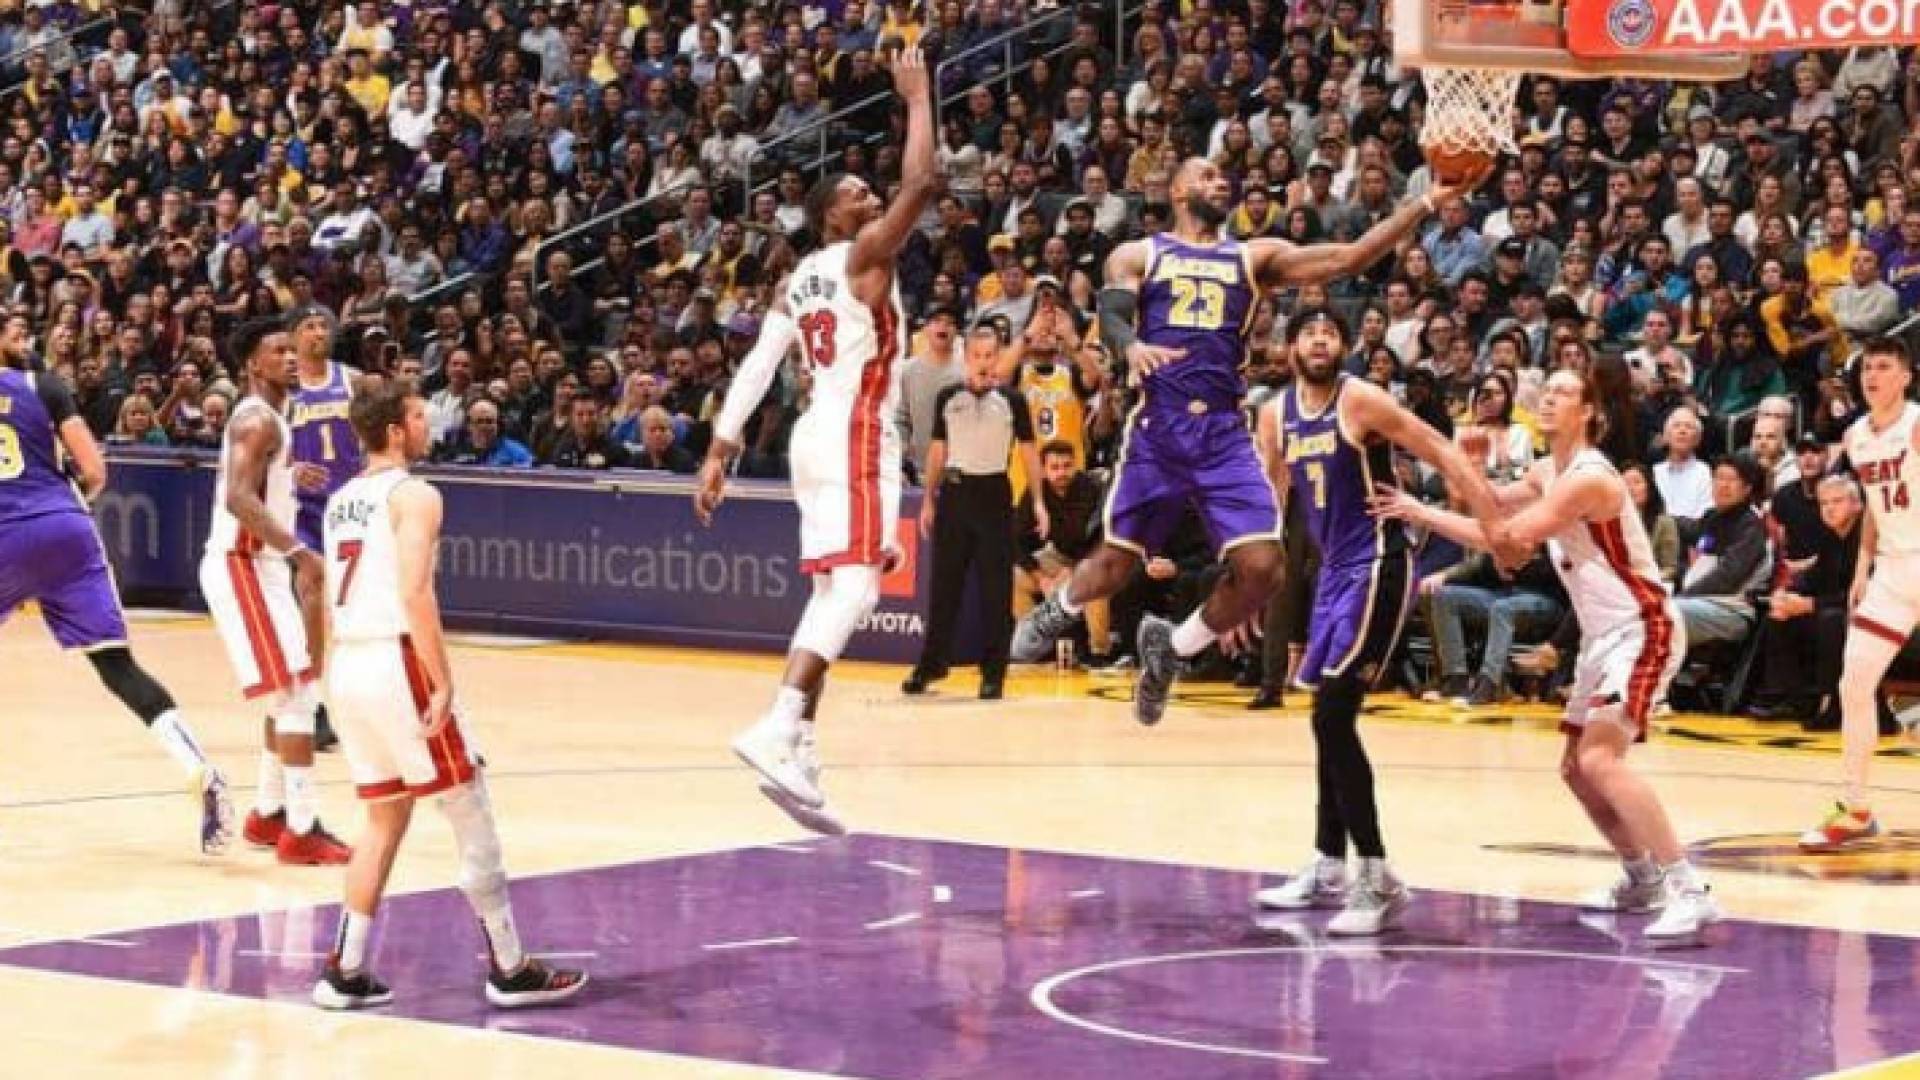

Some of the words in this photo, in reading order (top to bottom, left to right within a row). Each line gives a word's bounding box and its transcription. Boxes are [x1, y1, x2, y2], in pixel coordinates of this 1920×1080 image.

[1168, 278, 1223, 329] 23
[799, 308, 838, 370] 13
[319, 423, 335, 460] 1
[1306, 463, 1326, 509] 7
[1881, 482, 1910, 513] 14
[336, 539, 364, 608] 7
[436, 526, 790, 597] mmunications
